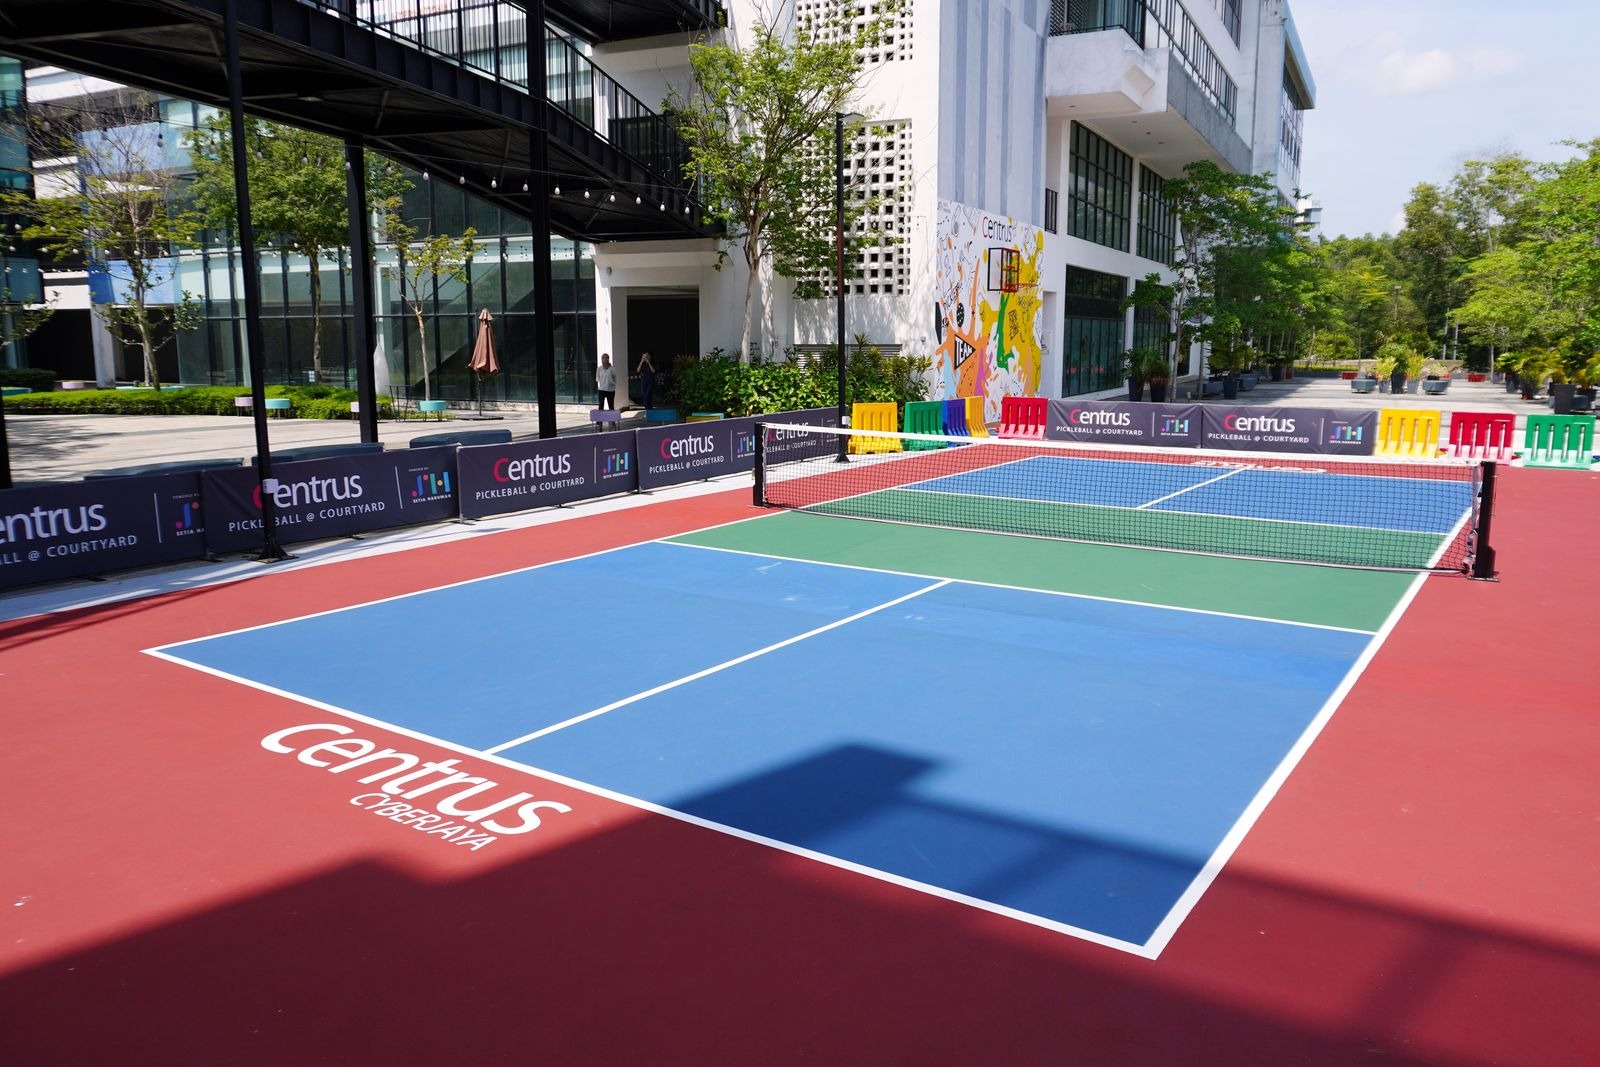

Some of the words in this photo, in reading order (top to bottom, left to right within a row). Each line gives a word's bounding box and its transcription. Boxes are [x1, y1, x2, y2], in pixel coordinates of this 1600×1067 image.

[956, 340, 974, 366] TEAM
[1070, 409, 1131, 426] Centrus
[1224, 413, 1296, 433] Centrus
[1056, 426, 1093, 434] PICKLEBALL
[1102, 428, 1143, 436] COURTYARD
[1208, 433, 1252, 441] PICKLEBALL
[1263, 435, 1310, 444] COURTYARD
[660, 435, 714, 459] Centrus
[493, 453, 571, 483] Centrus
[649, 462, 684, 474] PICKLEBALL
[692, 455, 725, 467] COURTYARD
[476, 485, 527, 500] PICKLEBALL
[530, 484, 537, 494] @
[540, 476, 585, 491] COURTYARD
[229, 513, 301, 532] PICKLBALL
[306, 513, 316, 522] @
[319, 501, 386, 519] COURTYARD
[0, 552, 22, 565] LL
[28, 550, 40, 561] @
[46, 535, 138, 557] COURTYARD
[349, 792, 498, 851] CYBERJAYA
